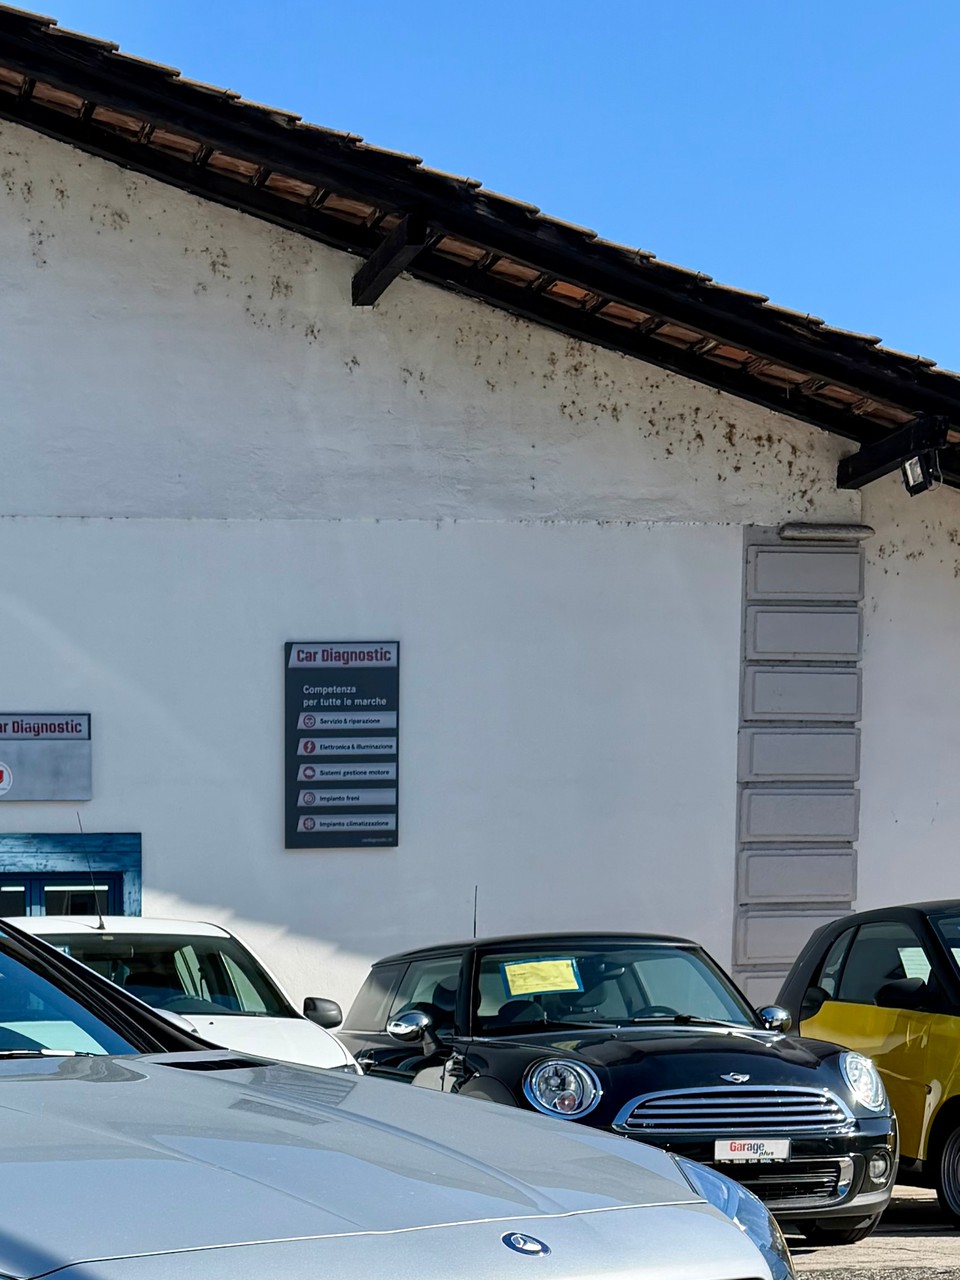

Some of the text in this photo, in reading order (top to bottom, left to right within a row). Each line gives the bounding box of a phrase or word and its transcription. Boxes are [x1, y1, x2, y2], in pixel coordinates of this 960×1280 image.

[296, 647, 392, 666] Car Diagnostic
[303, 684, 357, 696] Competenza
[303, 697, 387, 708] per tutte le marche
[349, 718, 381, 726] riparazione
[12, 719, 83, 736] Diagnostic
[343, 769, 368, 778] gestione
[320, 794, 360, 803] Impianto freni
[320, 820, 345, 828] Impianto
[730, 1142, 764, 1154] Garage
[758, 1150, 775, 1158] plus
